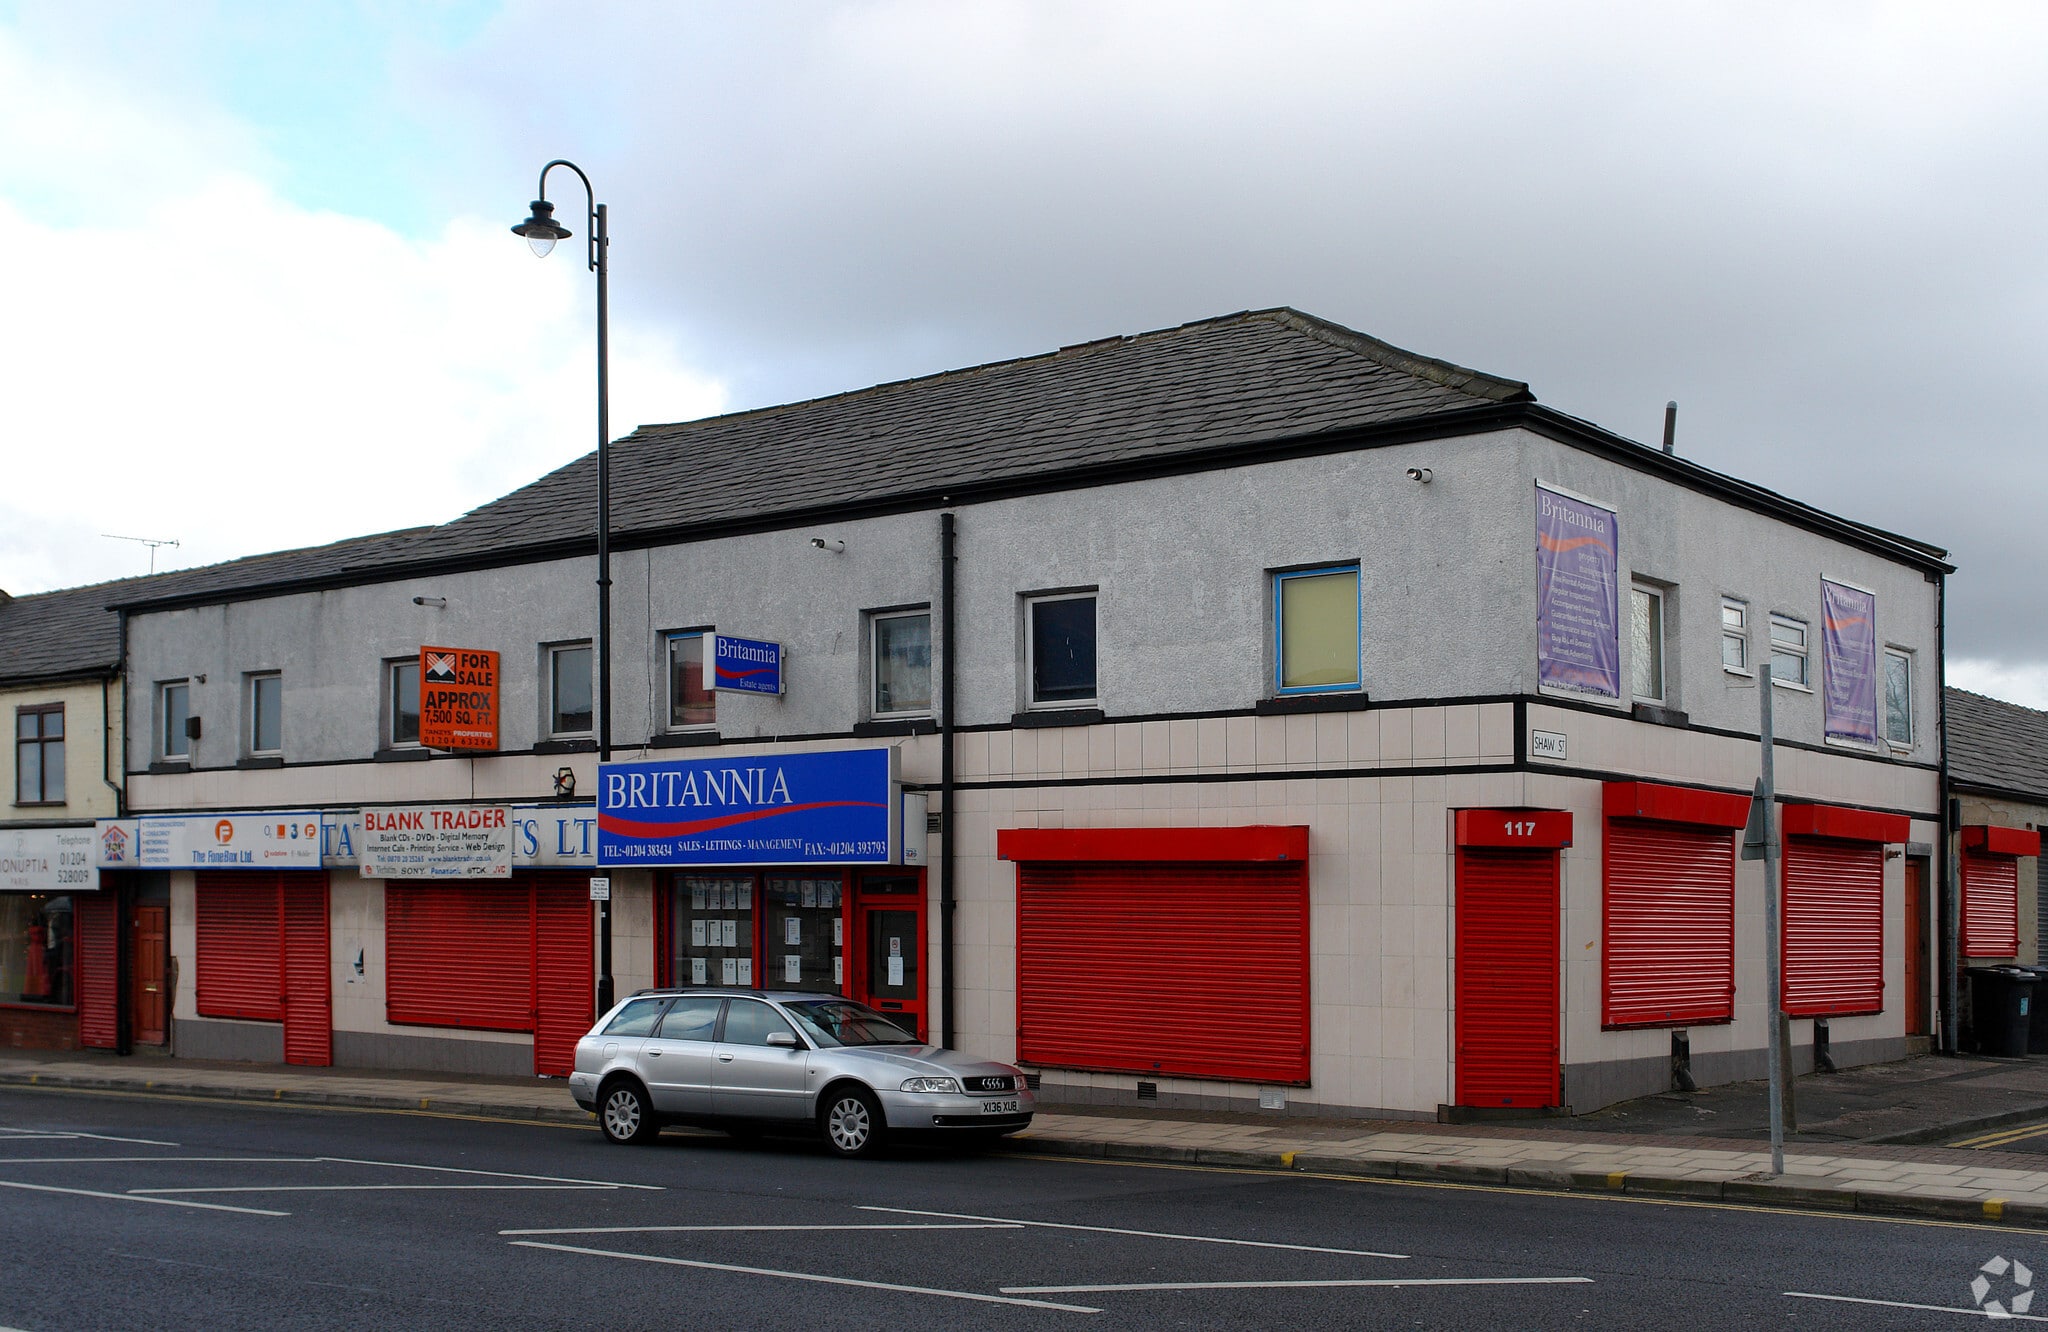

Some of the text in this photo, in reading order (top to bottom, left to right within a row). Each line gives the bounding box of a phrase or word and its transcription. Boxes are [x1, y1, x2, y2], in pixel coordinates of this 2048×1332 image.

[1542, 496, 1604, 533] Britannia
[1578, 552, 1599, 564] property
[1552, 598, 1580, 611] Accompanied
[1552, 622, 1580, 634] Maintenance
[1552, 634, 1561, 643] Buy
[718, 638, 776, 664] Britannia
[1552, 646, 1593, 662] Internet Advertising
[462, 654, 489, 669] FOR
[458, 671, 492, 686] SALE
[740, 678, 776, 691] Estate agents
[425, 692, 490, 710] APPROX
[425, 710, 492, 725] 7,500 SQ. FT.
[1535, 736, 1555, 751] SHAW
[606, 767, 793, 808] BRITANNIA
[365, 809, 505, 830] BLANK TRADER
[291, 823, 298, 839] 3
[1504, 821, 1536, 836] 117
[56, 835, 90, 848] Telephone
[440, 833, 460, 843] Digital
[462, 832, 488, 841] Memory
[410, 844, 435, 854] Printing
[437, 843, 459, 851] Service
[483, 842, 505, 852] Design
[647, 844, 672, 856] 383434
[678, 838, 803, 851] SALES LETTINGS MANAGEMENT
[857, 841, 886, 854] 393793
[60, 852, 86, 865] 01204
[192, 850, 254, 863] The FoneBox Ltd.
[58, 870, 88, 883] 528009
[493, 866, 505, 874] JVC
[983, 1102, 1002, 1113] X136
